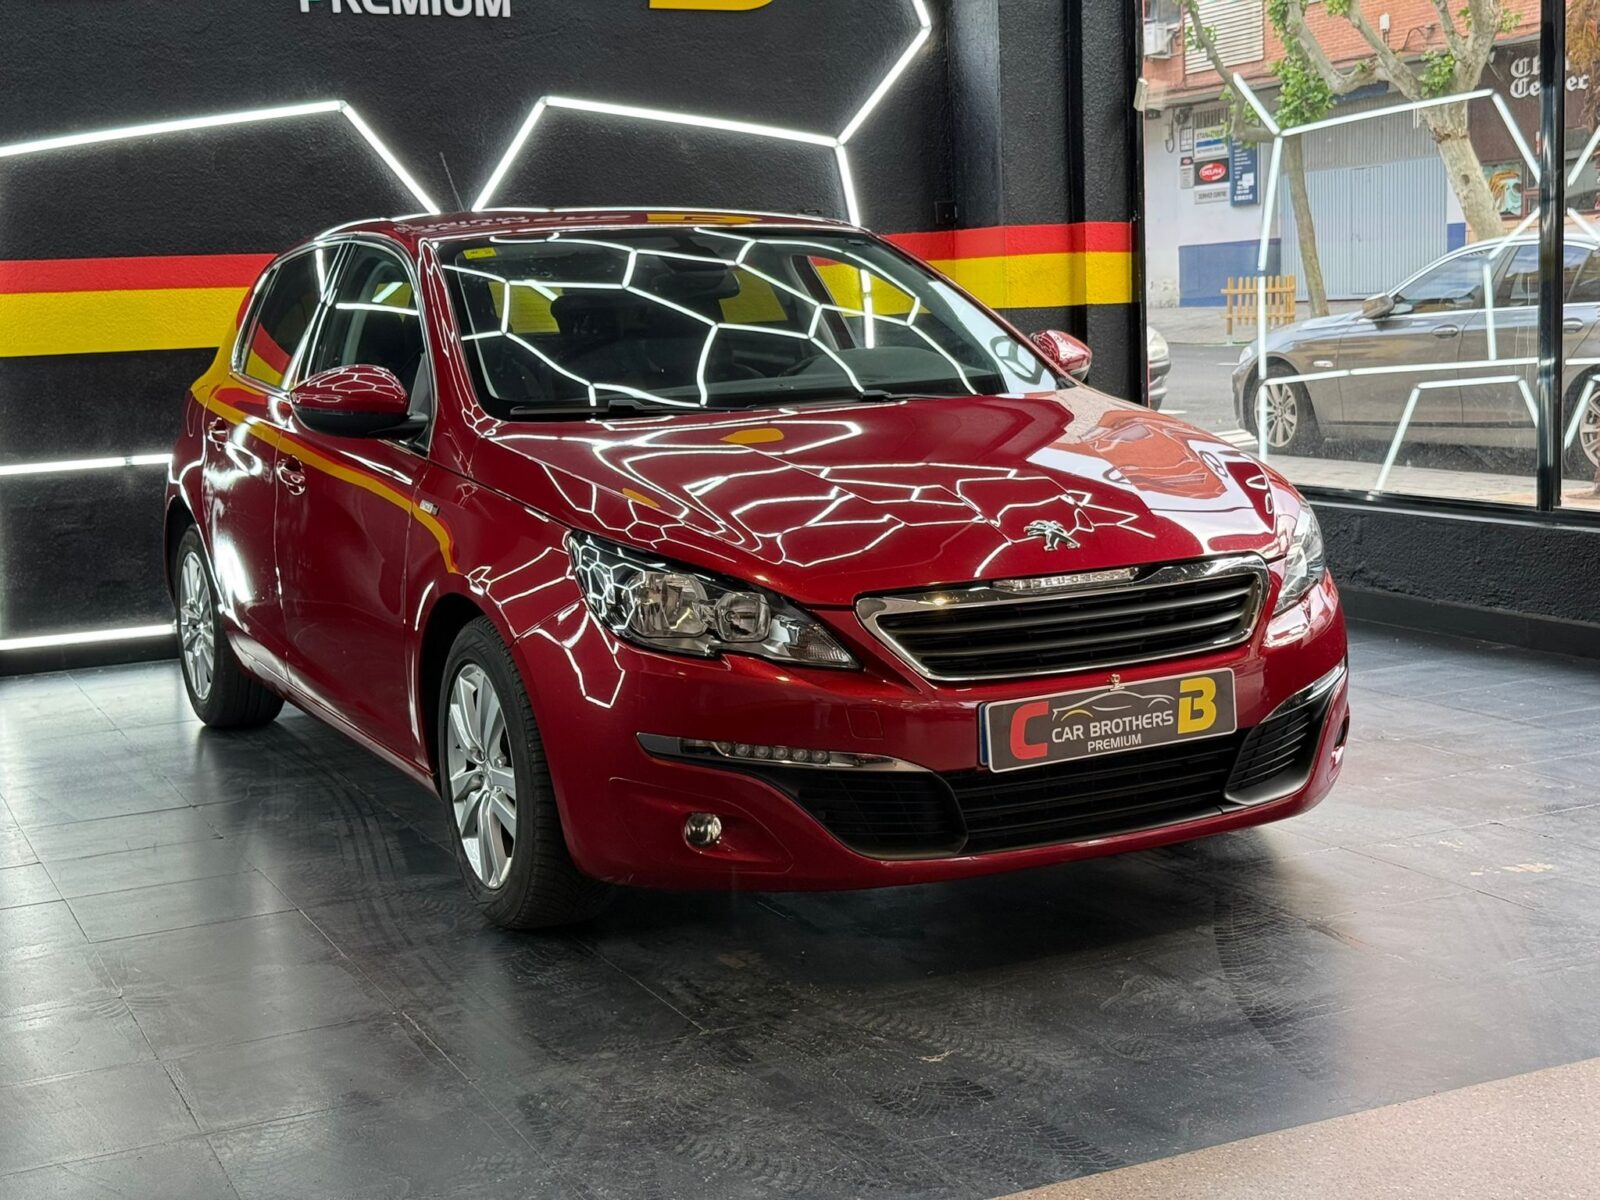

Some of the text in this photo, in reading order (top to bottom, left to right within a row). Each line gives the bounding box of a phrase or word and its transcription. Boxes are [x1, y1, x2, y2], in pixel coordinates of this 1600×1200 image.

[1509, 74, 1590, 98] Ceer
[1052, 710, 1174, 743] CAR BROTHERS
[1087, 733, 1142, 752] PREMIUM
